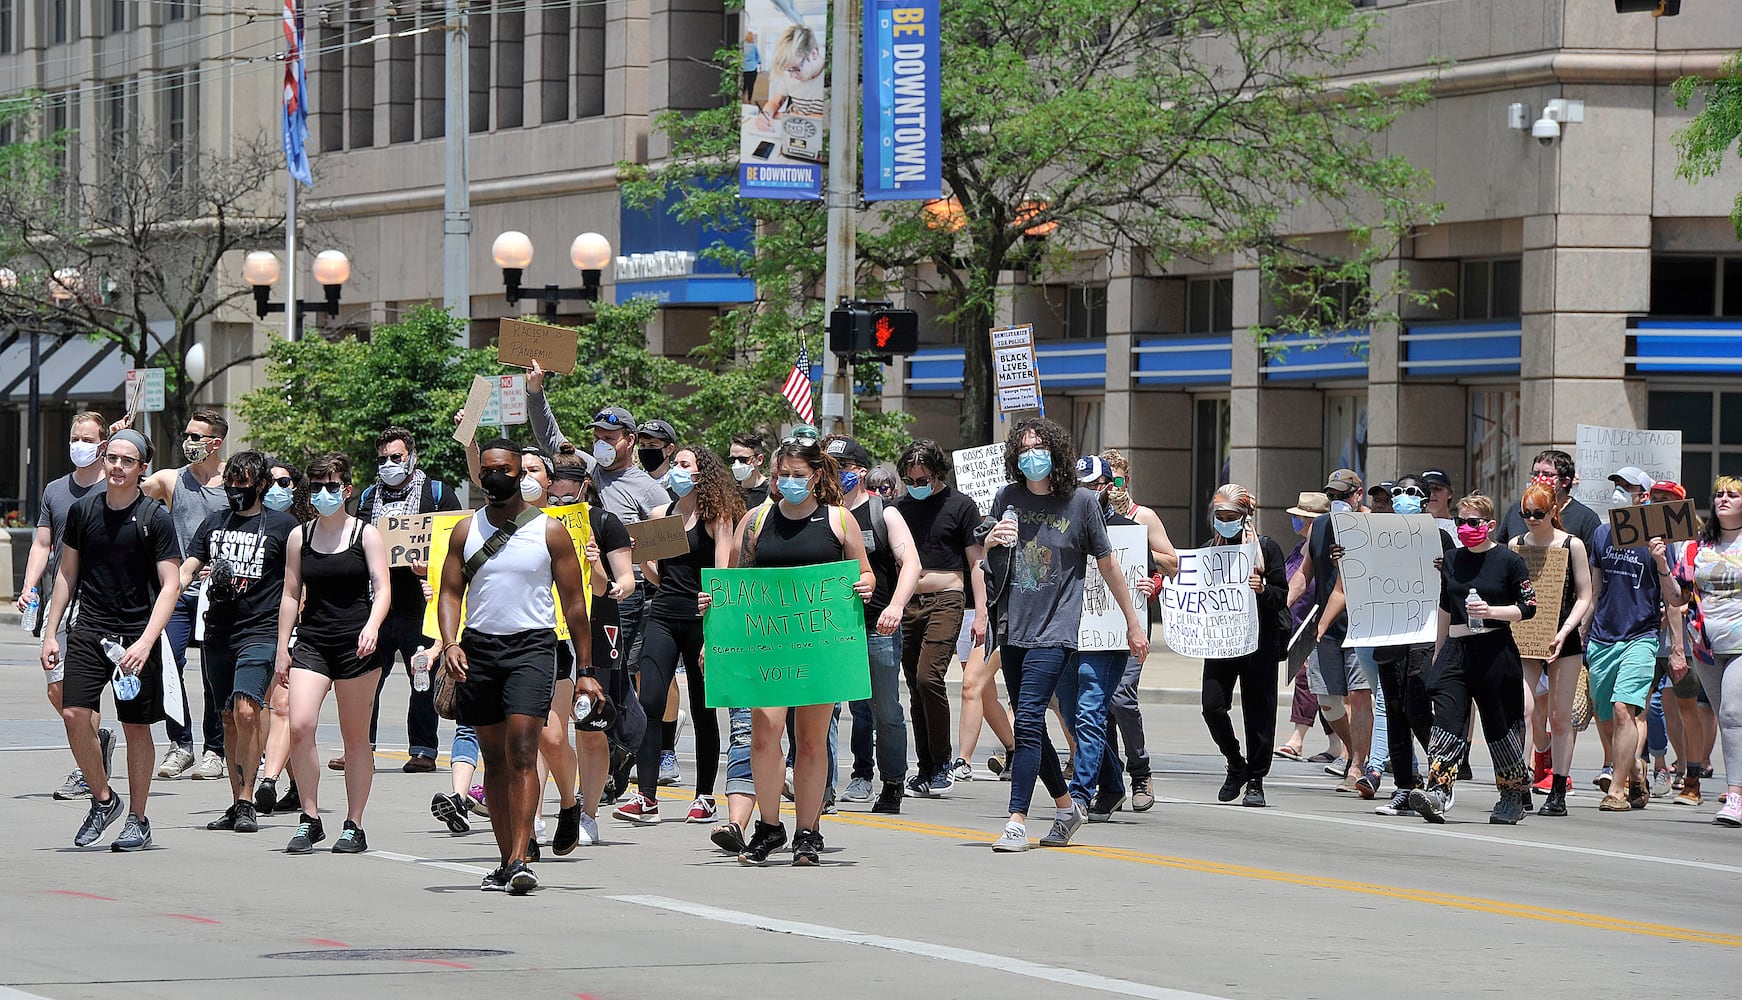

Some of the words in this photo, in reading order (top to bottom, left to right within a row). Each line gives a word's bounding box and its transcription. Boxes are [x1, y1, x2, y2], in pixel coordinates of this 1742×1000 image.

[892, 7, 926, 38] BE
[880, 18, 892, 178] DAYTON
[893, 43, 927, 190] DOWNTOWN.
[746, 166, 759, 180] BE
[759, 166, 815, 183] DOWNTOWN.
[512, 323, 549, 338] RACISM
[510, 341, 554, 359] PANDEMIC
[1000, 352, 1028, 363] BLACK
[999, 370, 1034, 381] MATTER
[1002, 362, 1028, 372] LIVES
[501, 377, 512, 388] NO
[1583, 427, 1592, 443] I
[1597, 428, 1676, 447] UNDERSTAND
[962, 448, 984, 462] ROSES
[985, 445, 999, 457] ARE
[1580, 448, 1605, 463] THAT
[1611, 450, 1619, 463] I
[1625, 451, 1664, 466] WILL
[955, 460, 988, 475] DORITOS
[990, 456, 1005, 468] ARE
[959, 481, 975, 492] THE
[988, 476, 1004, 486] PRIS
[388, 516, 431, 531] DE-F
[1334, 512, 1423, 551] Black
[1612, 502, 1694, 547] BLM
[1605, 545, 1639, 566] Inspires
[232, 562, 263, 577] OLICE
[1202, 550, 1249, 587] SAID
[1342, 556, 1425, 595] Proud
[709, 577, 774, 609] BLACK
[777, 576, 856, 607] LIVES
[1208, 587, 1244, 613] SAID
[745, 607, 844, 637] MATTER
[1176, 613, 1203, 627] BLACK
[1169, 622, 1198, 638] KNOW
[1202, 626, 1219, 639] ALL
[1225, 637, 1242, 648] HELP
[759, 664, 809, 682] VOTE
